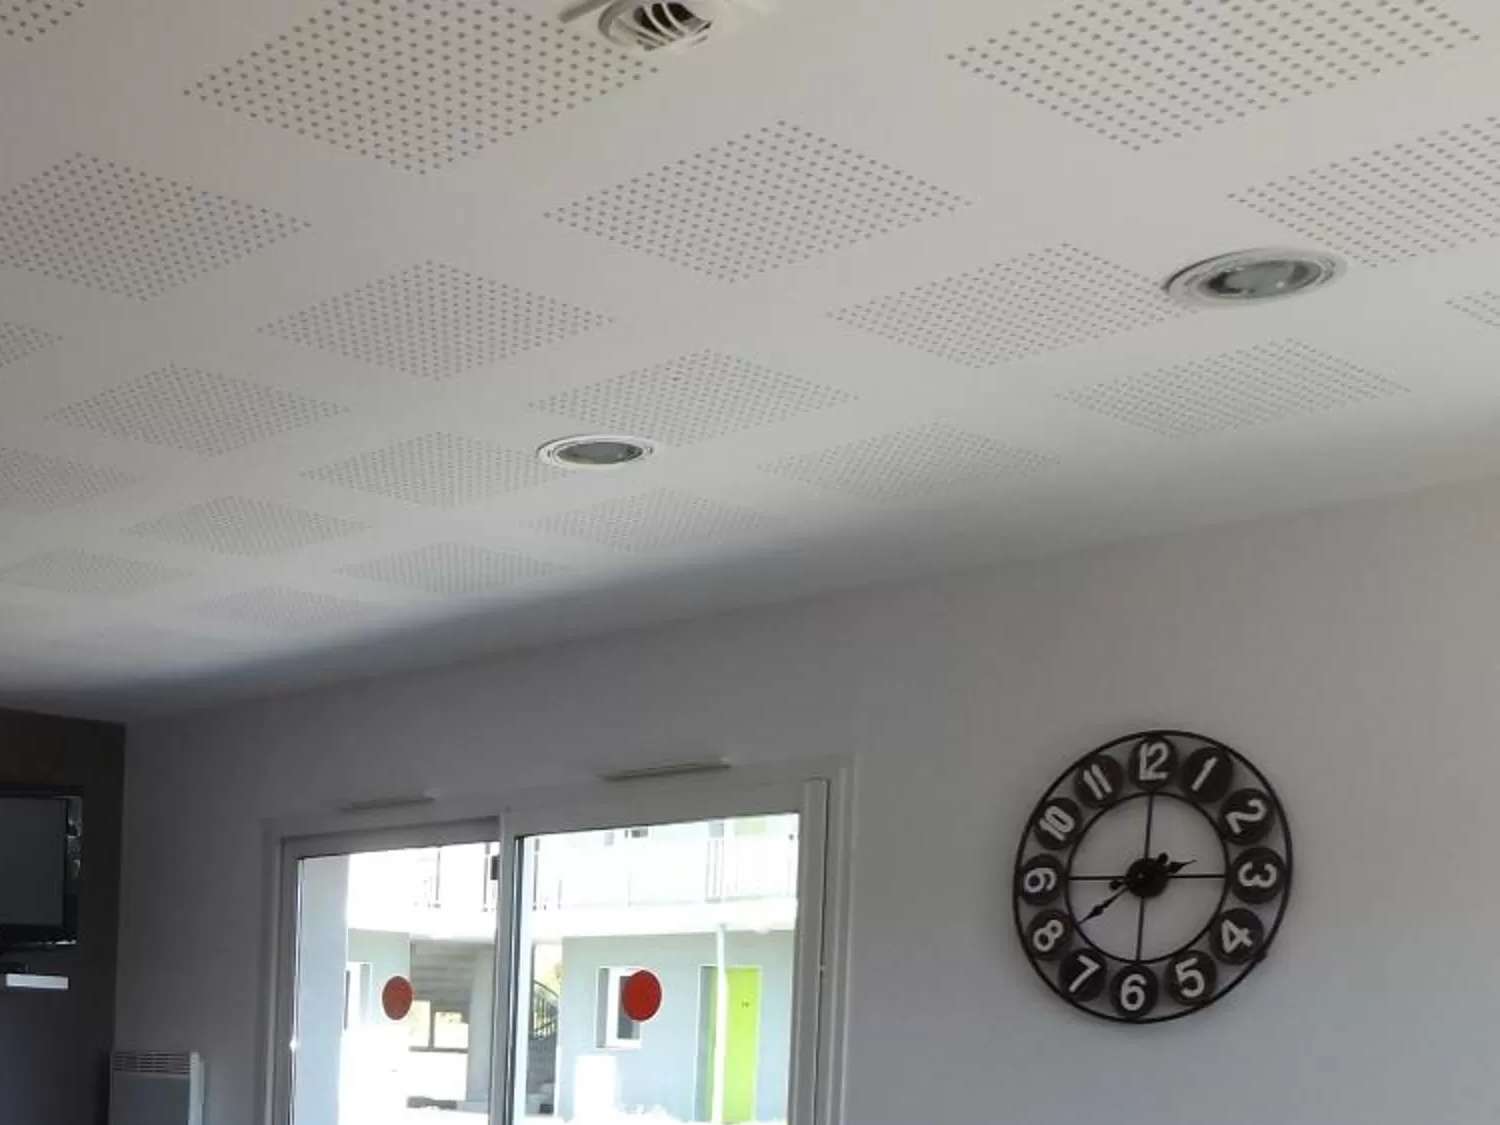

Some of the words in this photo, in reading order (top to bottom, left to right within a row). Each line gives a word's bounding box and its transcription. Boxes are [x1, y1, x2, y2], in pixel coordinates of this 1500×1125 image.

[1138, 741, 1170, 781] 12
[1191, 756, 1218, 792] 1
[1082, 763, 1113, 799] 11
[1039, 805, 1076, 841] 10
[1226, 799, 1268, 835] 2
[1023, 867, 1057, 893] 9
[1237, 861, 1277, 888] 3
[1033, 919, 1064, 952] 8
[1220, 919, 1253, 953] 4
[1068, 955, 1100, 993] 7
[1175, 957, 1205, 998] 5
[1120, 974, 1147, 1011] 6
